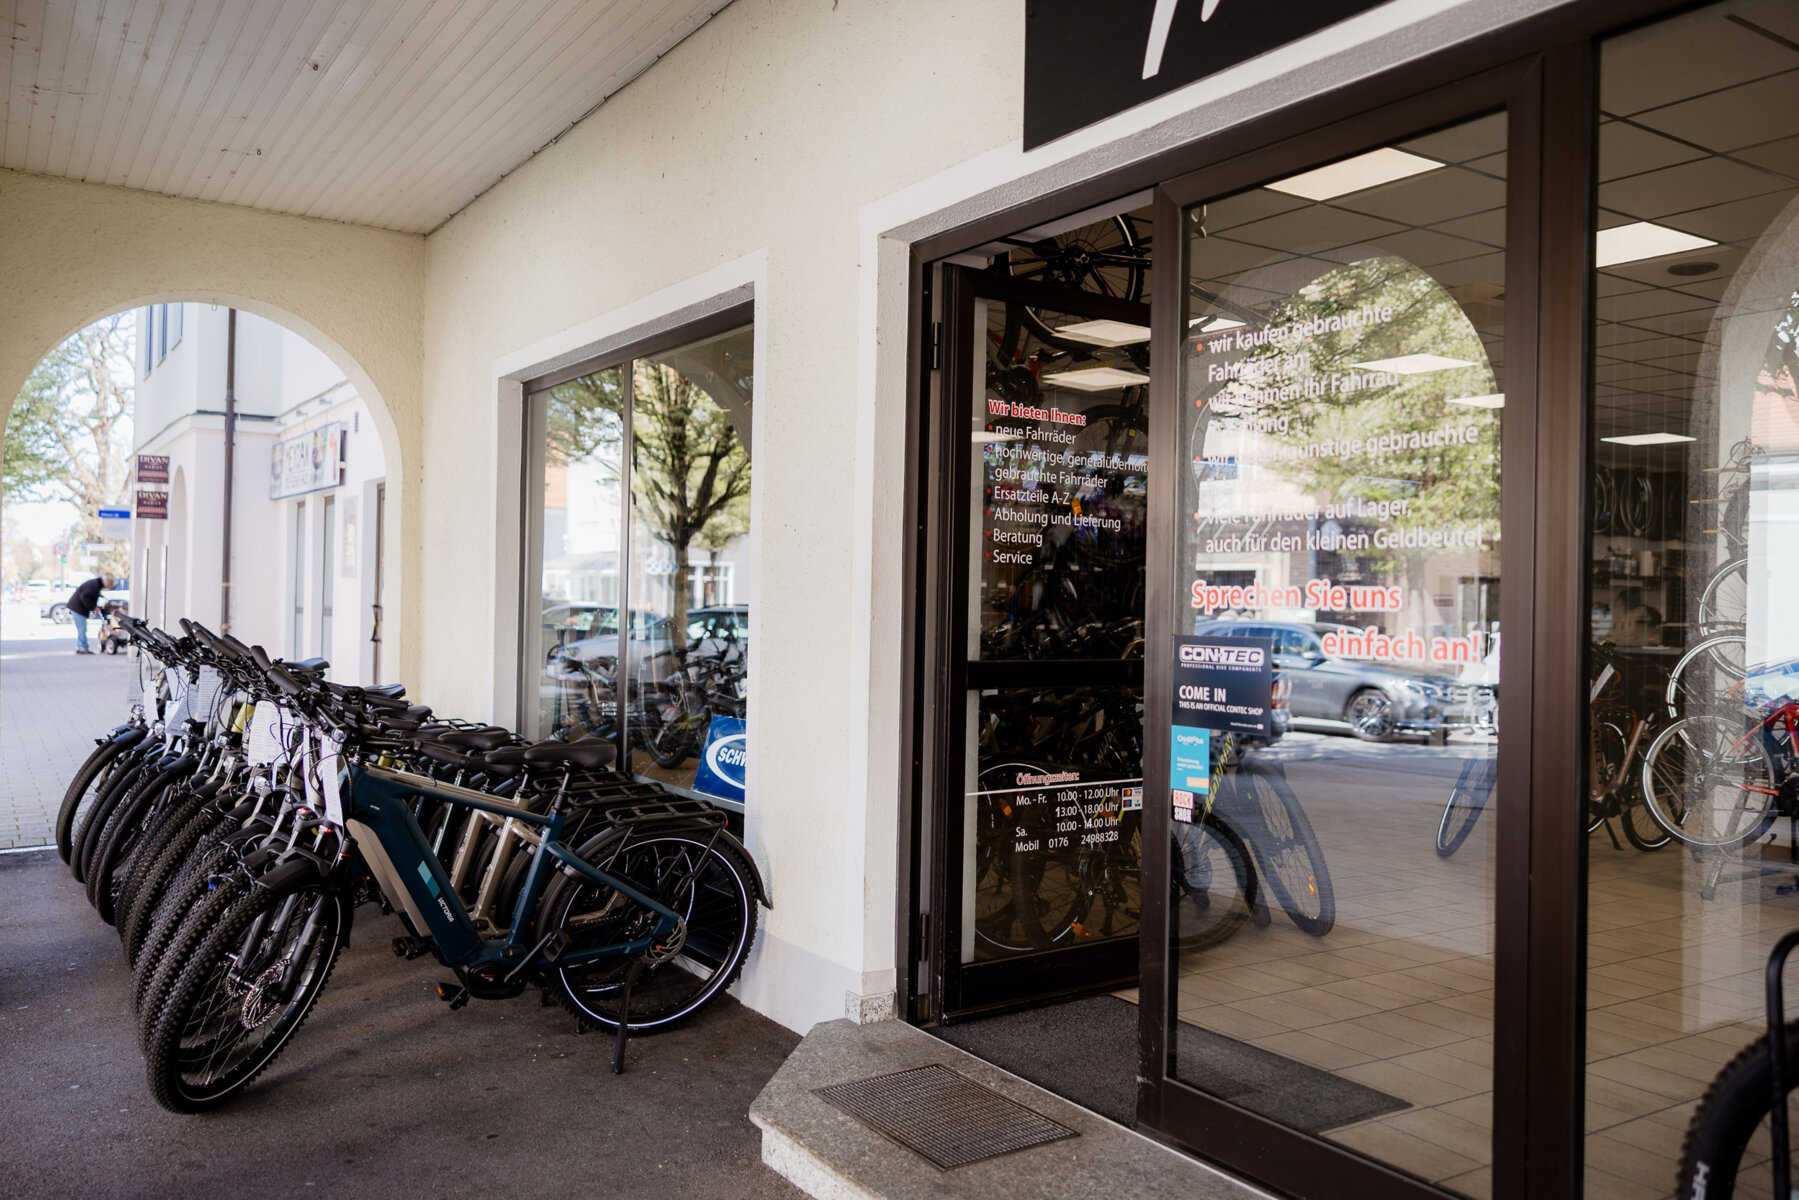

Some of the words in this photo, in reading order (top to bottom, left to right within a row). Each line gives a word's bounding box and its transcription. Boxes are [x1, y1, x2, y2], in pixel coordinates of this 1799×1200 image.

[1209, 334, 1235, 354] wir
[1236, 325, 1289, 350] kaufen
[1293, 305, 1393, 342] gebrauchte
[1304, 377, 1328, 398] Ihr
[1331, 365, 1400, 394] Fahrrad
[988, 399, 1009, 416] Wir
[1011, 402, 1049, 421] bieten
[1050, 407, 1087, 426] Ihnen:
[995, 425, 1023, 438] neue
[1025, 426, 1077, 445] Fahrräder
[1291, 437, 1364, 464] günstige
[1366, 423, 1479, 452] gebrauchte
[995, 444, 1066, 467] hochwertige,
[995, 466, 1057, 484] gebrauchte
[1059, 472, 1109, 489] Fahrräder
[994, 486, 1049, 504] Ersatzteile
[1051, 491, 1070, 505] A-Z
[994, 507, 1048, 527] Abholung
[1051, 513, 1071, 526] und
[1074, 514, 1121, 533] Lieferung
[1325, 498, 1352, 521] auf
[1357, 498, 1412, 522] Lager,
[993, 529, 1043, 547] Beratung
[1205, 534, 1241, 554] auch
[1244, 532, 1267, 552] für
[1270, 531, 1302, 551] den
[1305, 530, 1370, 551] kleinen
[993, 549, 1033, 566] Service
[1191, 579, 1301, 615] Sprechen
[1304, 578, 1349, 612] Sie
[1350, 584, 1403, 613] uns
[1320, 625, 1428, 662] einfach
[1430, 635, 1482, 664] an!
[1179, 685, 1210, 701] COME
[1214, 687, 1227, 703] IN
[1179, 701, 1190, 709] THIS
[1196, 702, 1204, 710] AN
[1204, 703, 1226, 712] OFFICIAL
[1227, 705, 1248, 714] CONTEC
[1248, 707, 1264, 716] SHOP
[1016, 796, 1032, 806] Mo.
[1038, 794, 1048, 804] Fr.
[1056, 791, 1077, 802] 10.00
[1084, 789, 1104, 800] 12.00
[1105, 787, 1119, 798] Uhr
[1055, 807, 1077, 818] 13.00
[1084, 804, 1104, 815] 18.00
[1105, 802, 1119, 812] Uhr
[1015, 826, 1028, 837] Sa.
[1056, 821, 1077, 832] 10.00
[1084, 818, 1104, 829] 14.00
[1105, 817, 1119, 827] Uhr
[1015, 840, 1039, 853] Mobil
[1048, 837, 1069, 849] 0176
